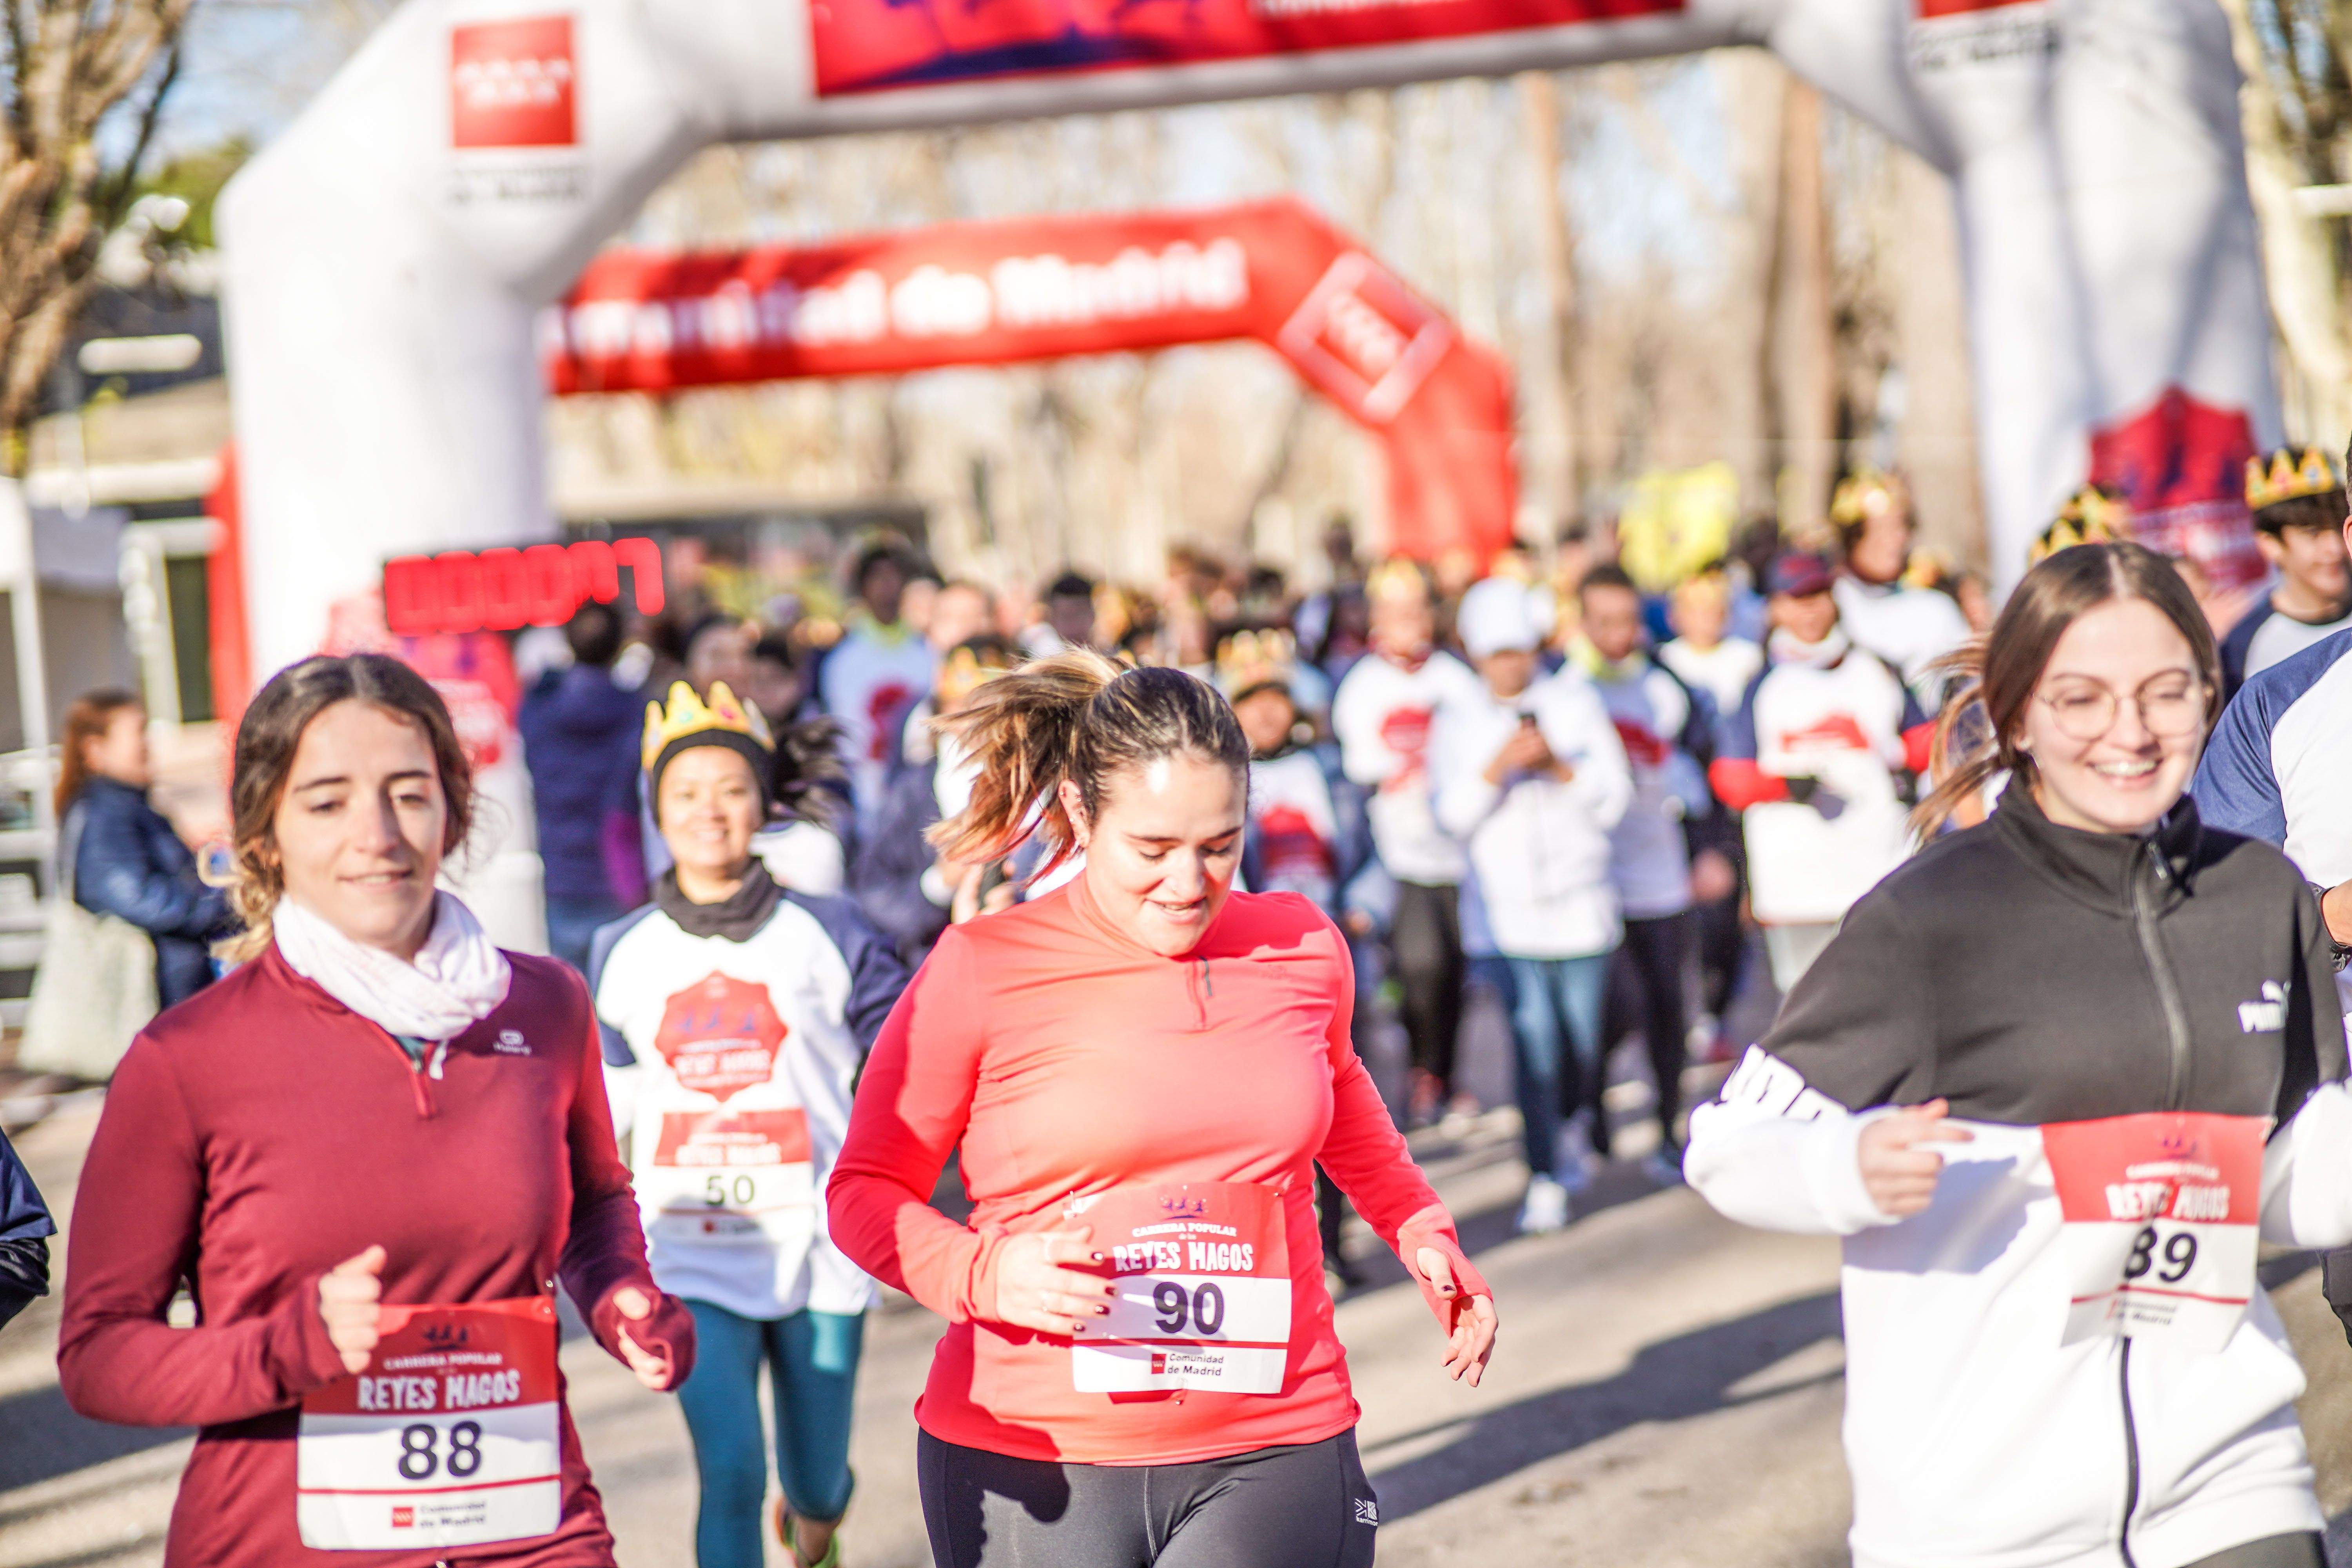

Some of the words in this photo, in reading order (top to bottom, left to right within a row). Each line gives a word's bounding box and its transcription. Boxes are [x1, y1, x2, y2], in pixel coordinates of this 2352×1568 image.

[706, 1174, 755, 1207] 50
[1132, 1223, 1187, 1237] CARRERA
[1188, 1222, 1237, 1237] POPULAR
[1112, 1241, 1181, 1271] REYES
[1188, 1241, 1253, 1271] MAGOS
[2124, 1225, 2197, 1283] 89
[1152, 1282, 1224, 1335] 90
[1169, 1354, 1224, 1363] Comunidad
[1183, 1366, 1222, 1376] Madrid
[358, 1376, 438, 1411] REYES
[445, 1369, 520, 1410] MAGOS
[397, 1420, 482, 1480] 88
